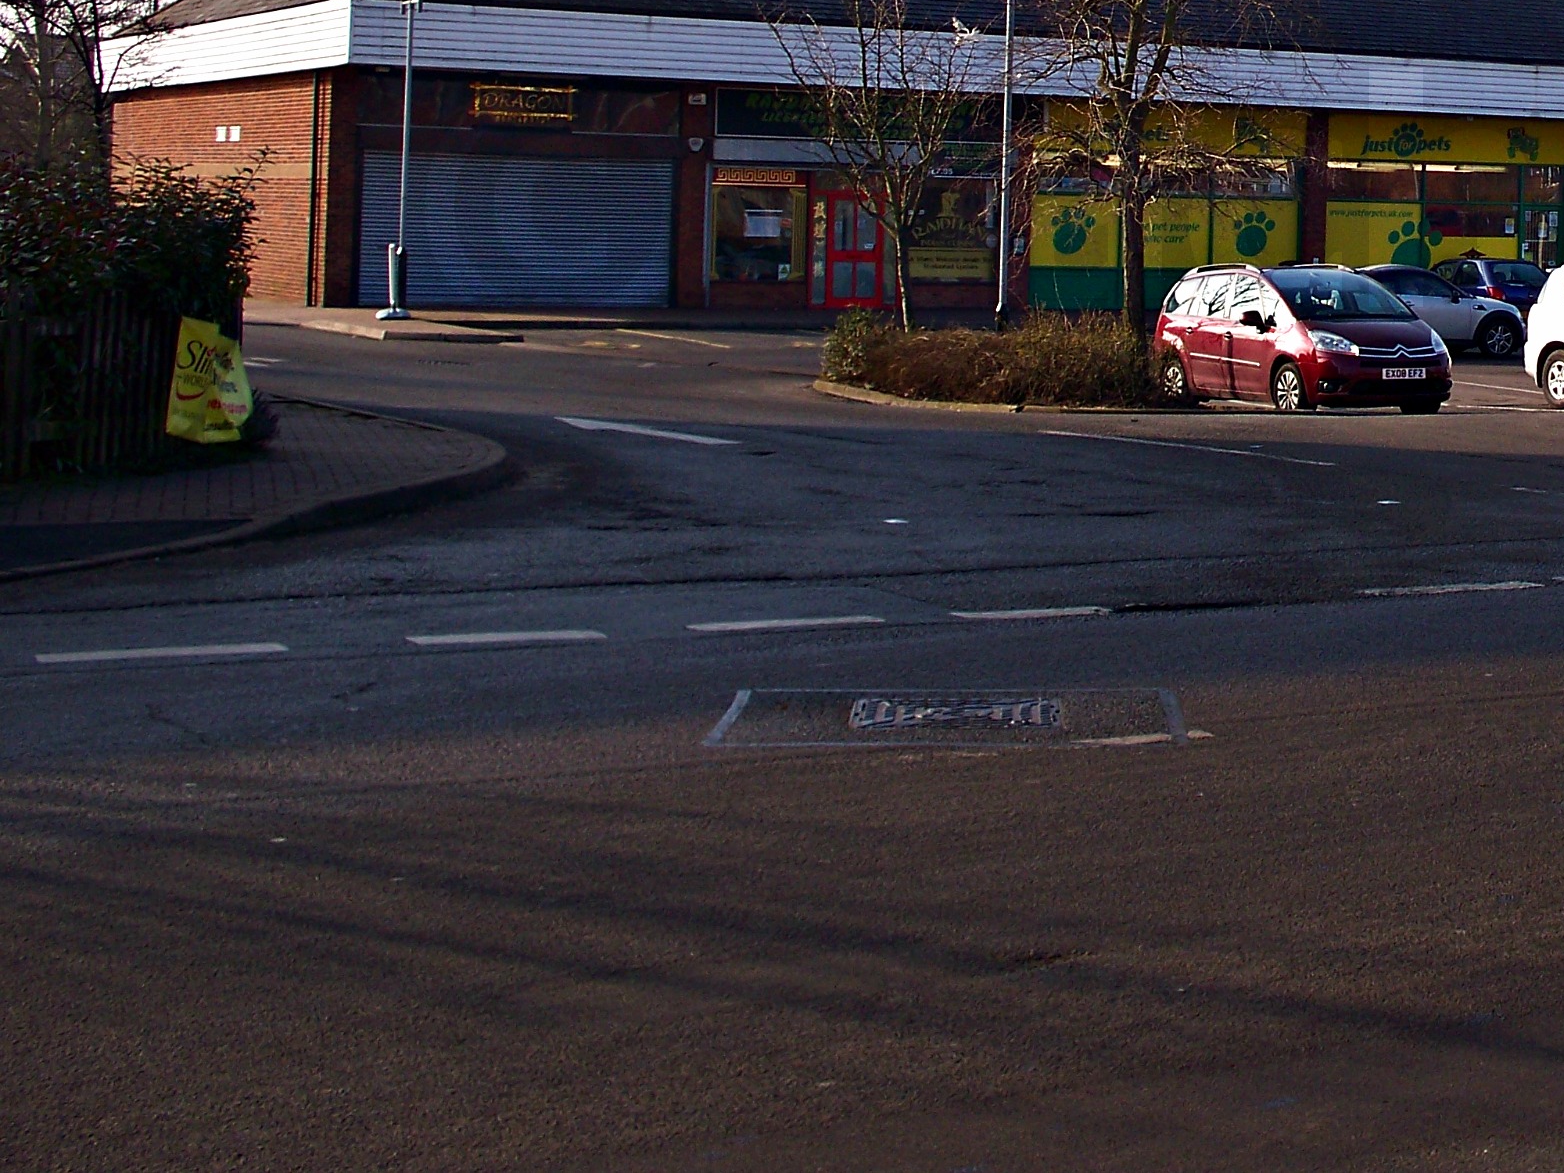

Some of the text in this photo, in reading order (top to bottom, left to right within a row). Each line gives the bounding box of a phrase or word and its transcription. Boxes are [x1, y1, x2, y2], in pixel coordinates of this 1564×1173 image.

[482, 92, 564, 109] DRAGON
[1360, 134, 1451, 155] just for pets
[1385, 369, 1406, 377] EX08
